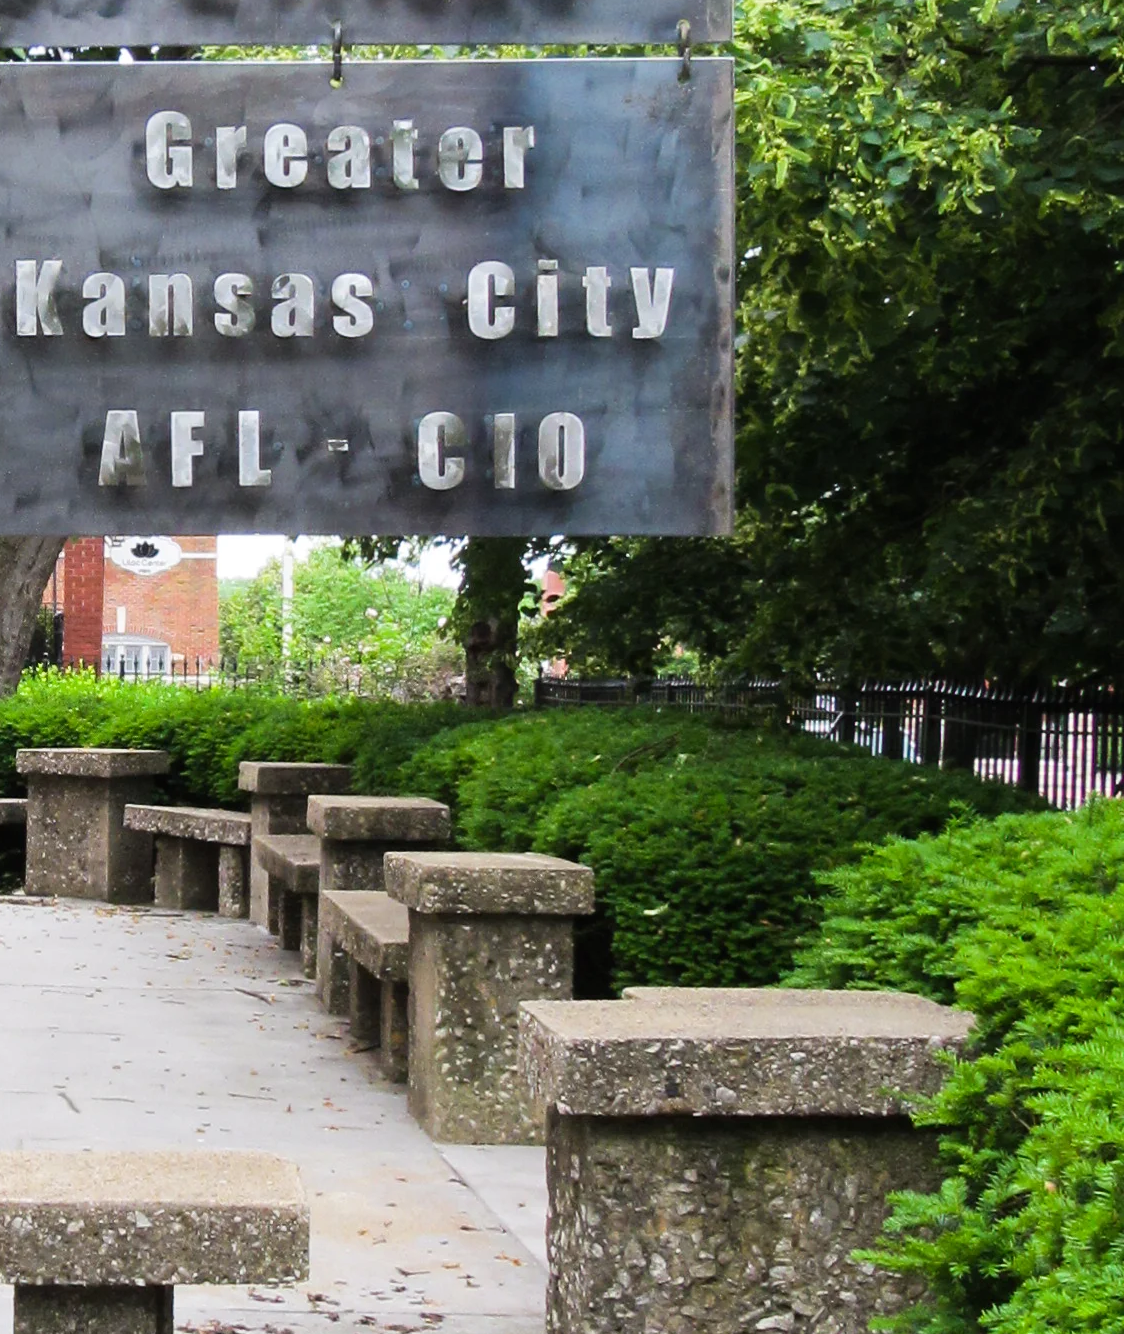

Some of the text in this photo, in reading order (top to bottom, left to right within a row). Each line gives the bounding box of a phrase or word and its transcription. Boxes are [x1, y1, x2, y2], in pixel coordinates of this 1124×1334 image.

[144, 109, 535, 191] Greater
[13, 258, 675, 340] Kansas City
